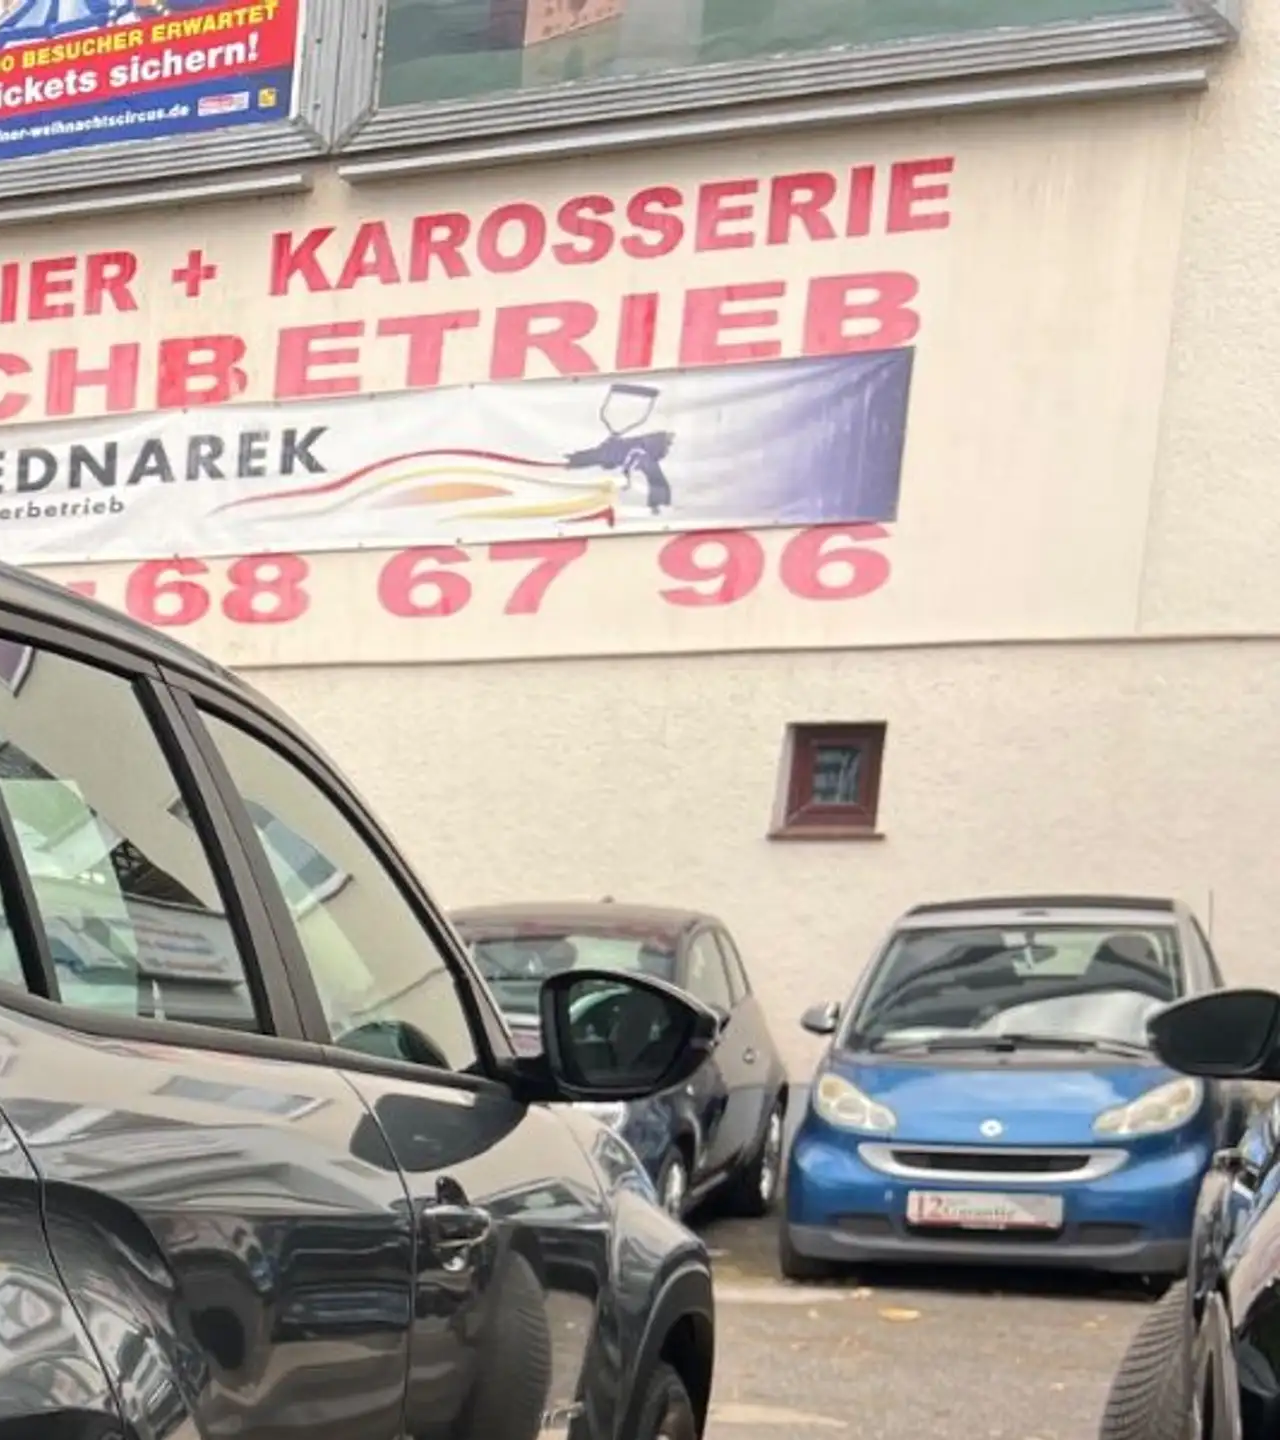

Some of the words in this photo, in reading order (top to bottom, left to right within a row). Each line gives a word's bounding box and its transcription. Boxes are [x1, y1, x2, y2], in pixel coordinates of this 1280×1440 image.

[22, 27, 144, 73] BESUCHER
[151, 1, 280, 44] ERWARTET
[108, 32, 261, 89] sichern!
[171, 250, 218, 298] +
[269, 155, 956, 297] KAROSSERIE
[378, 538, 588, 617] 67
[660, 523, 891, 606] 96
